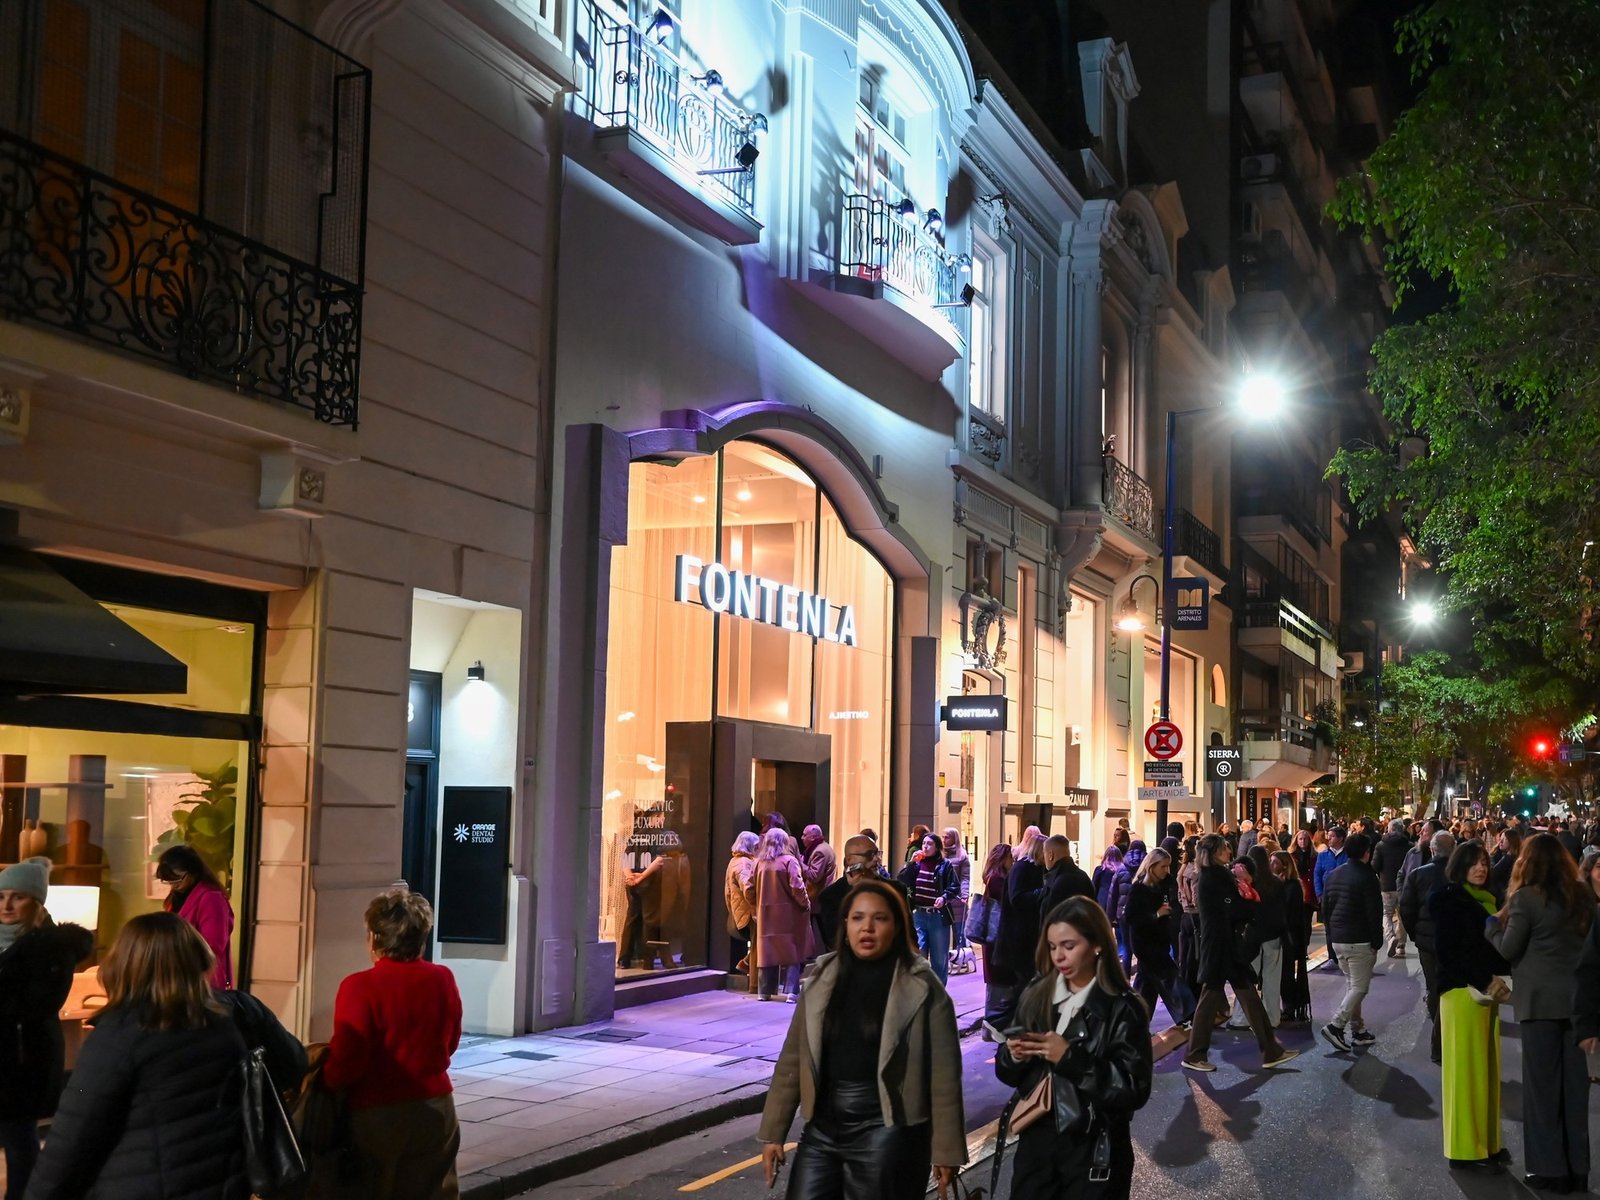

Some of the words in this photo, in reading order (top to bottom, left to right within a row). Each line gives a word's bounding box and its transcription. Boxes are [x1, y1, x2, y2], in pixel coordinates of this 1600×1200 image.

[675, 554, 857, 647] FONTENLA
[951, 708, 999, 718] FONTENLA
[1208, 749, 1240, 759] SIERRA
[1143, 789, 1185, 798] ARTEMIDE
[624, 833, 679, 846] ASTERPIECES
